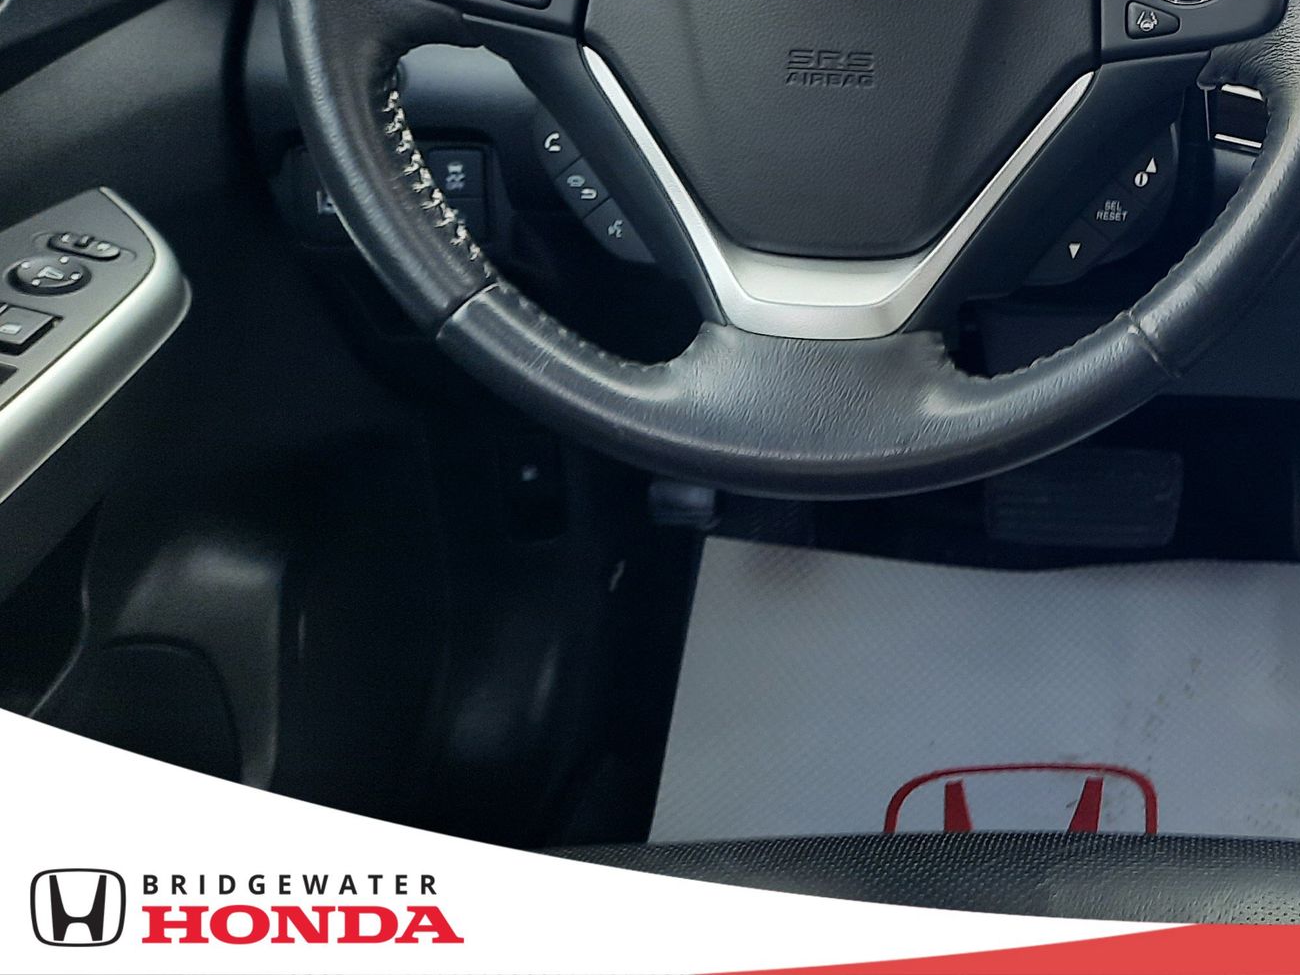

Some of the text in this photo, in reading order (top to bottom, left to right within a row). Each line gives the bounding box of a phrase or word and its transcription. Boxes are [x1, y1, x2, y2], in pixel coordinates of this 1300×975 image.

[788, 49, 875, 70] SRS
[785, 71, 875, 89] AIRBAG
[1104, 199, 1121, 211] SEL
[1096, 211, 1128, 222] RESET
